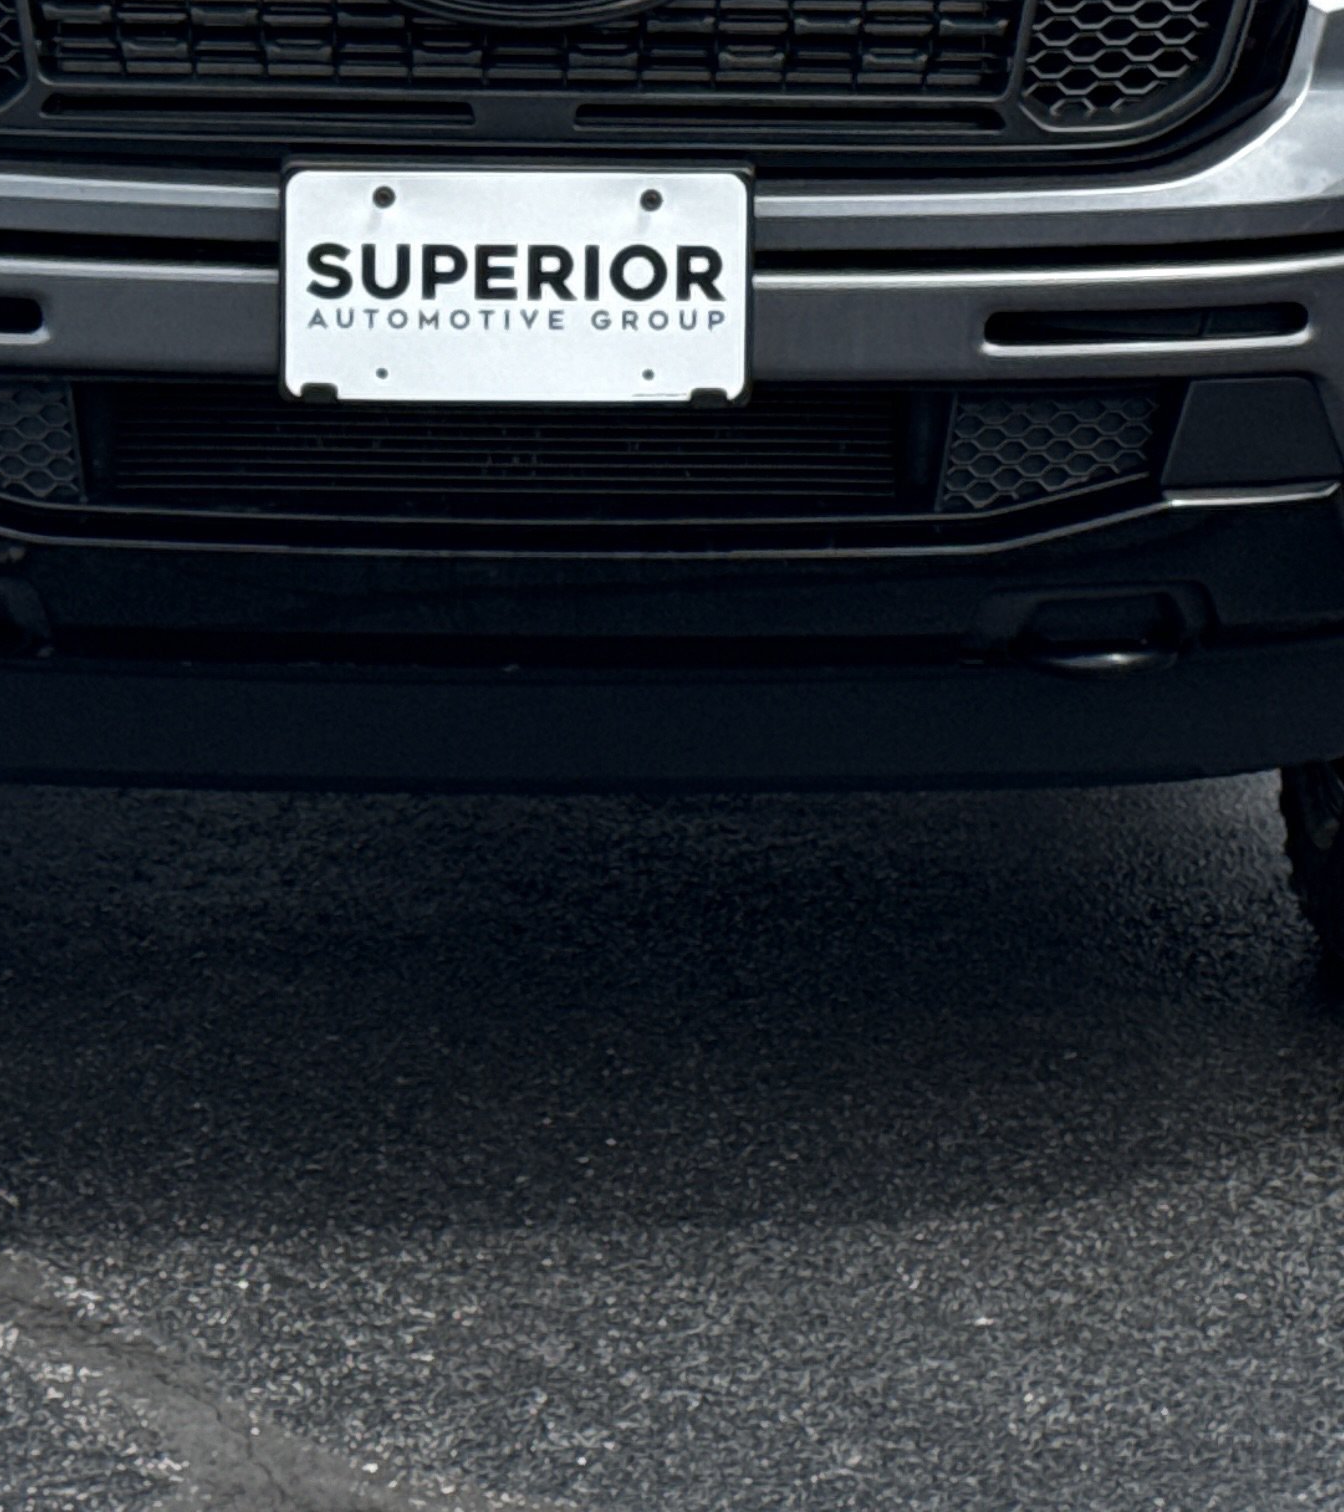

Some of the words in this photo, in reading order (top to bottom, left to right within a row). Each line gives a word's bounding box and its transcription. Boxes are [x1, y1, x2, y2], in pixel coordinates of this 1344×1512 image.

[306, 242, 726, 302] SUPERIOR
[306, 308, 565, 331] AUTOMOTIVE
[590, 309, 726, 332] GROUP
